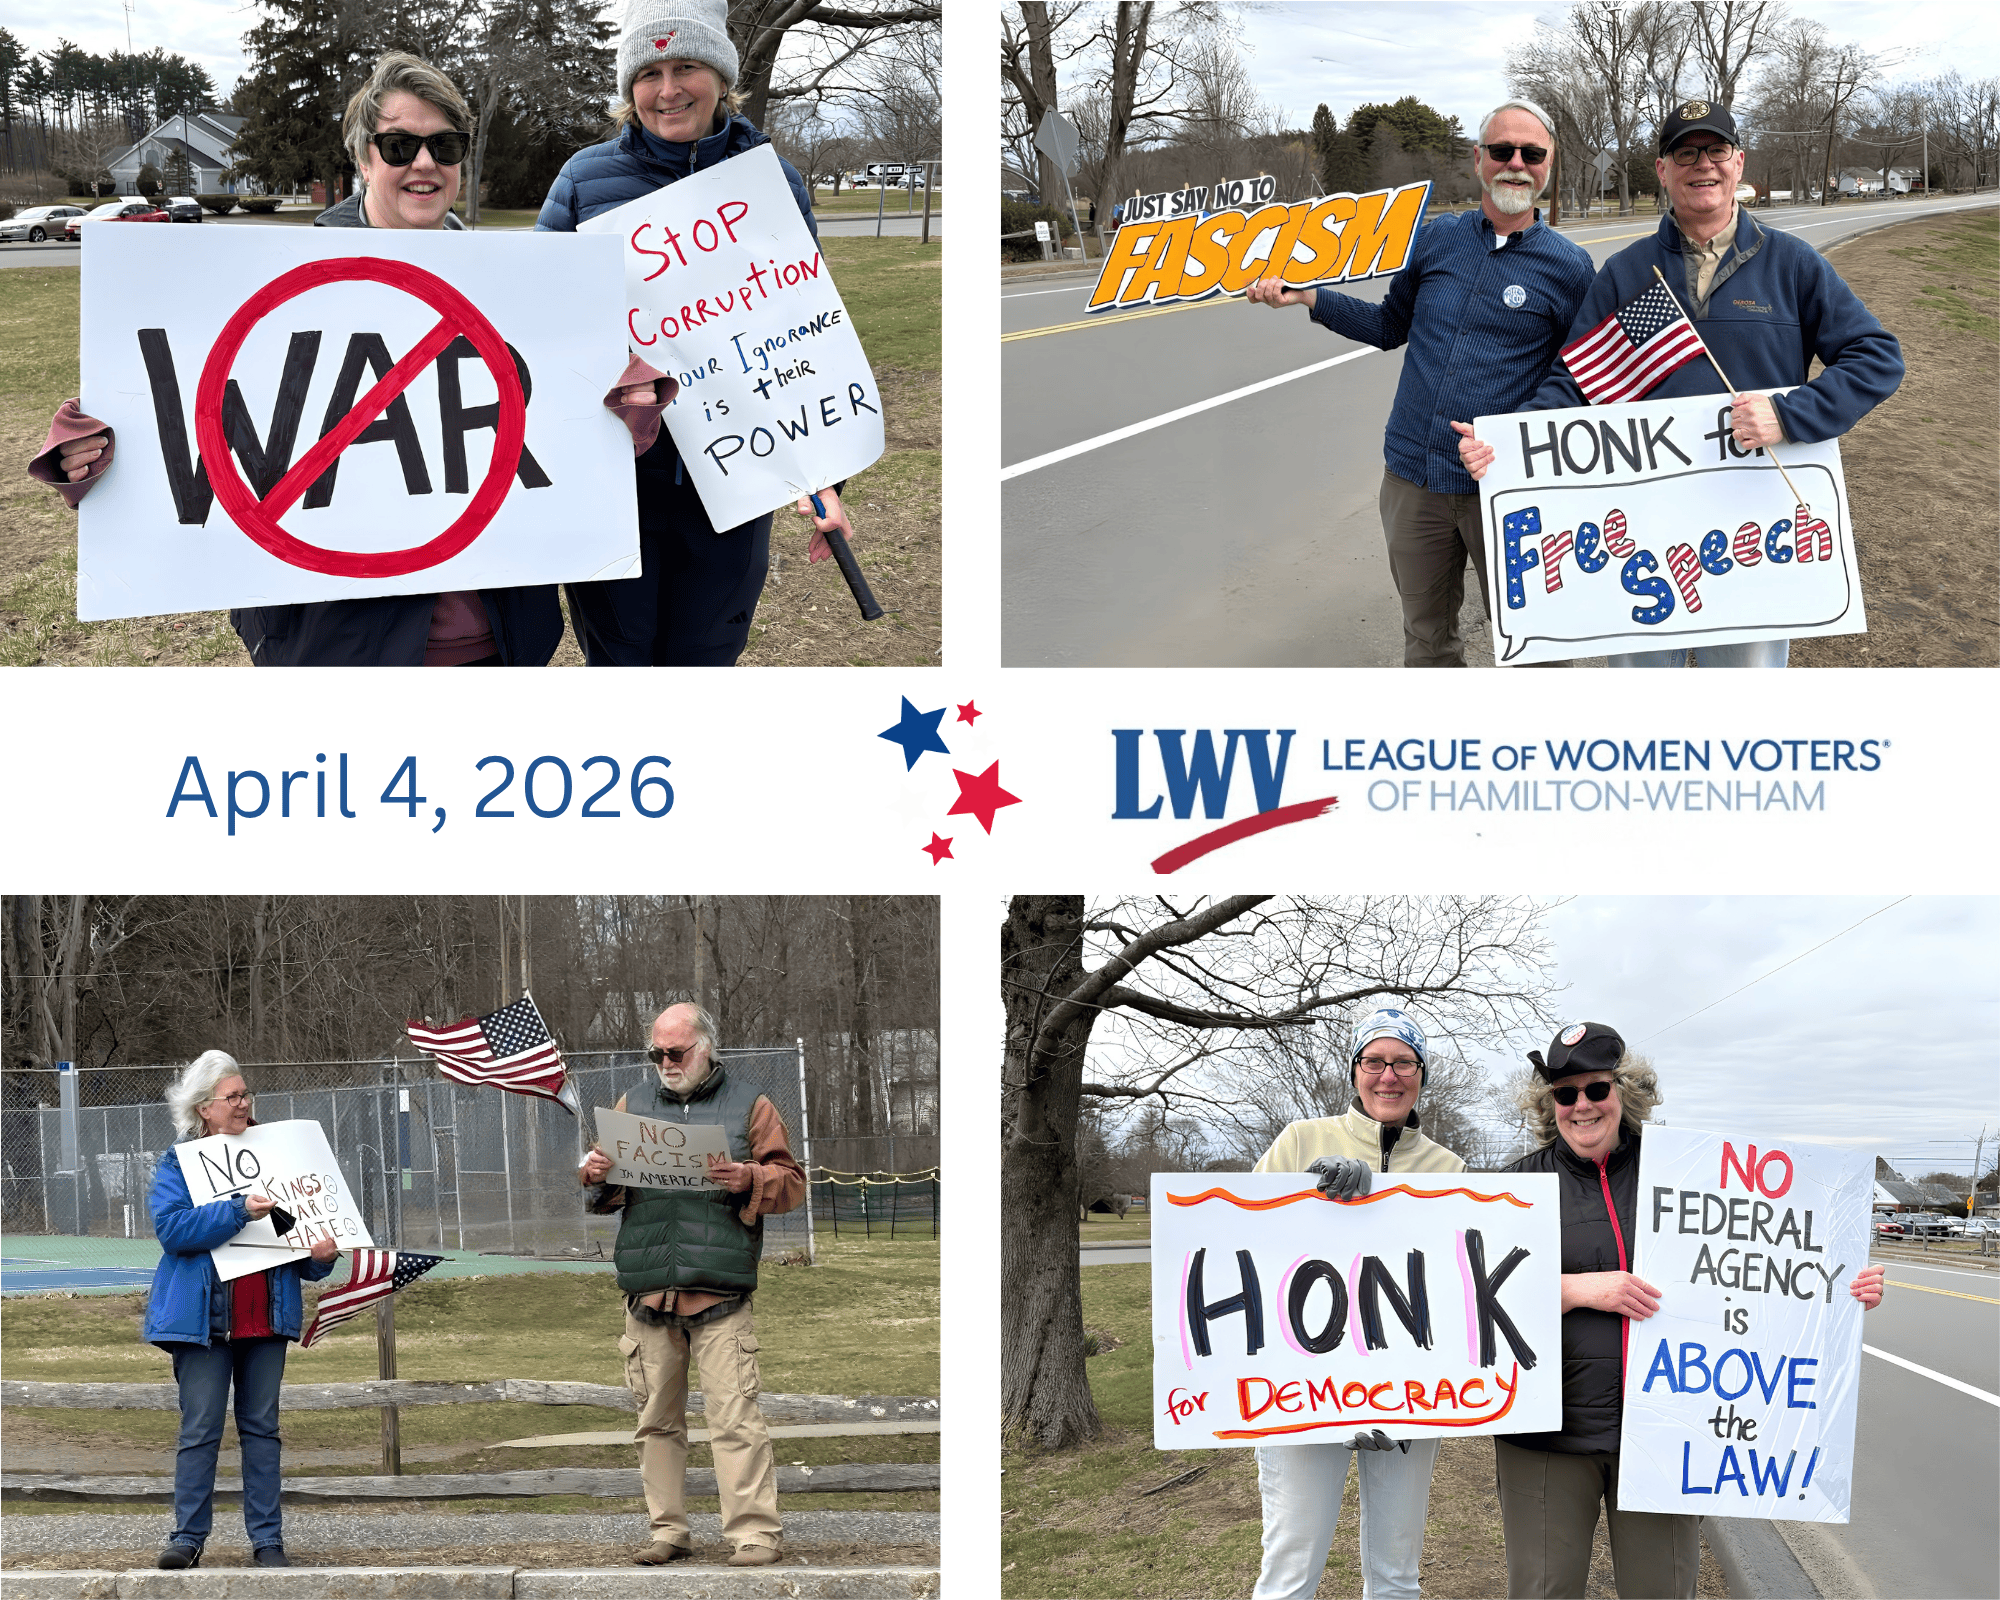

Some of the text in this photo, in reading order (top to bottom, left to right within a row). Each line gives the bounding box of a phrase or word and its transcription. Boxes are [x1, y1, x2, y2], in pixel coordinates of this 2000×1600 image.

[1124, 176, 1275, 222] JUST SAY NO TO
[1089, 184, 1427, 307] FASCISM
[667, 358, 723, 400] OUR
[138, 328, 553, 527] WAR
[704, 399, 730, 422] is
[704, 382, 878, 476] POWER
[1519, 415, 1693, 479] HONK
[1503, 503, 1832, 625] Free Speech
[616, 1140, 727, 1168] FACISM
[639, 1122, 687, 1148] NO
[198, 1144, 261, 1194] NO
[261, 1173, 322, 1203] KINGS
[619, 1168, 715, 1187] IN AMERICA
[1719, 1141, 1794, 1199] NO
[285, 1218, 344, 1252] HATE
[1652, 1185, 1823, 1253] FEDERAL
[1184, 1228, 1538, 1371] HONK
[1690, 1243, 1846, 1304] AGENCY
[1724, 1296, 1749, 1336] is
[1164, 1361, 1518, 1426] for DEMOCRACY
[1642, 1338, 1818, 1410] ABOVE
[1708, 1404, 1758, 1442] the
[1681, 1440, 1820, 1501] LAW!
